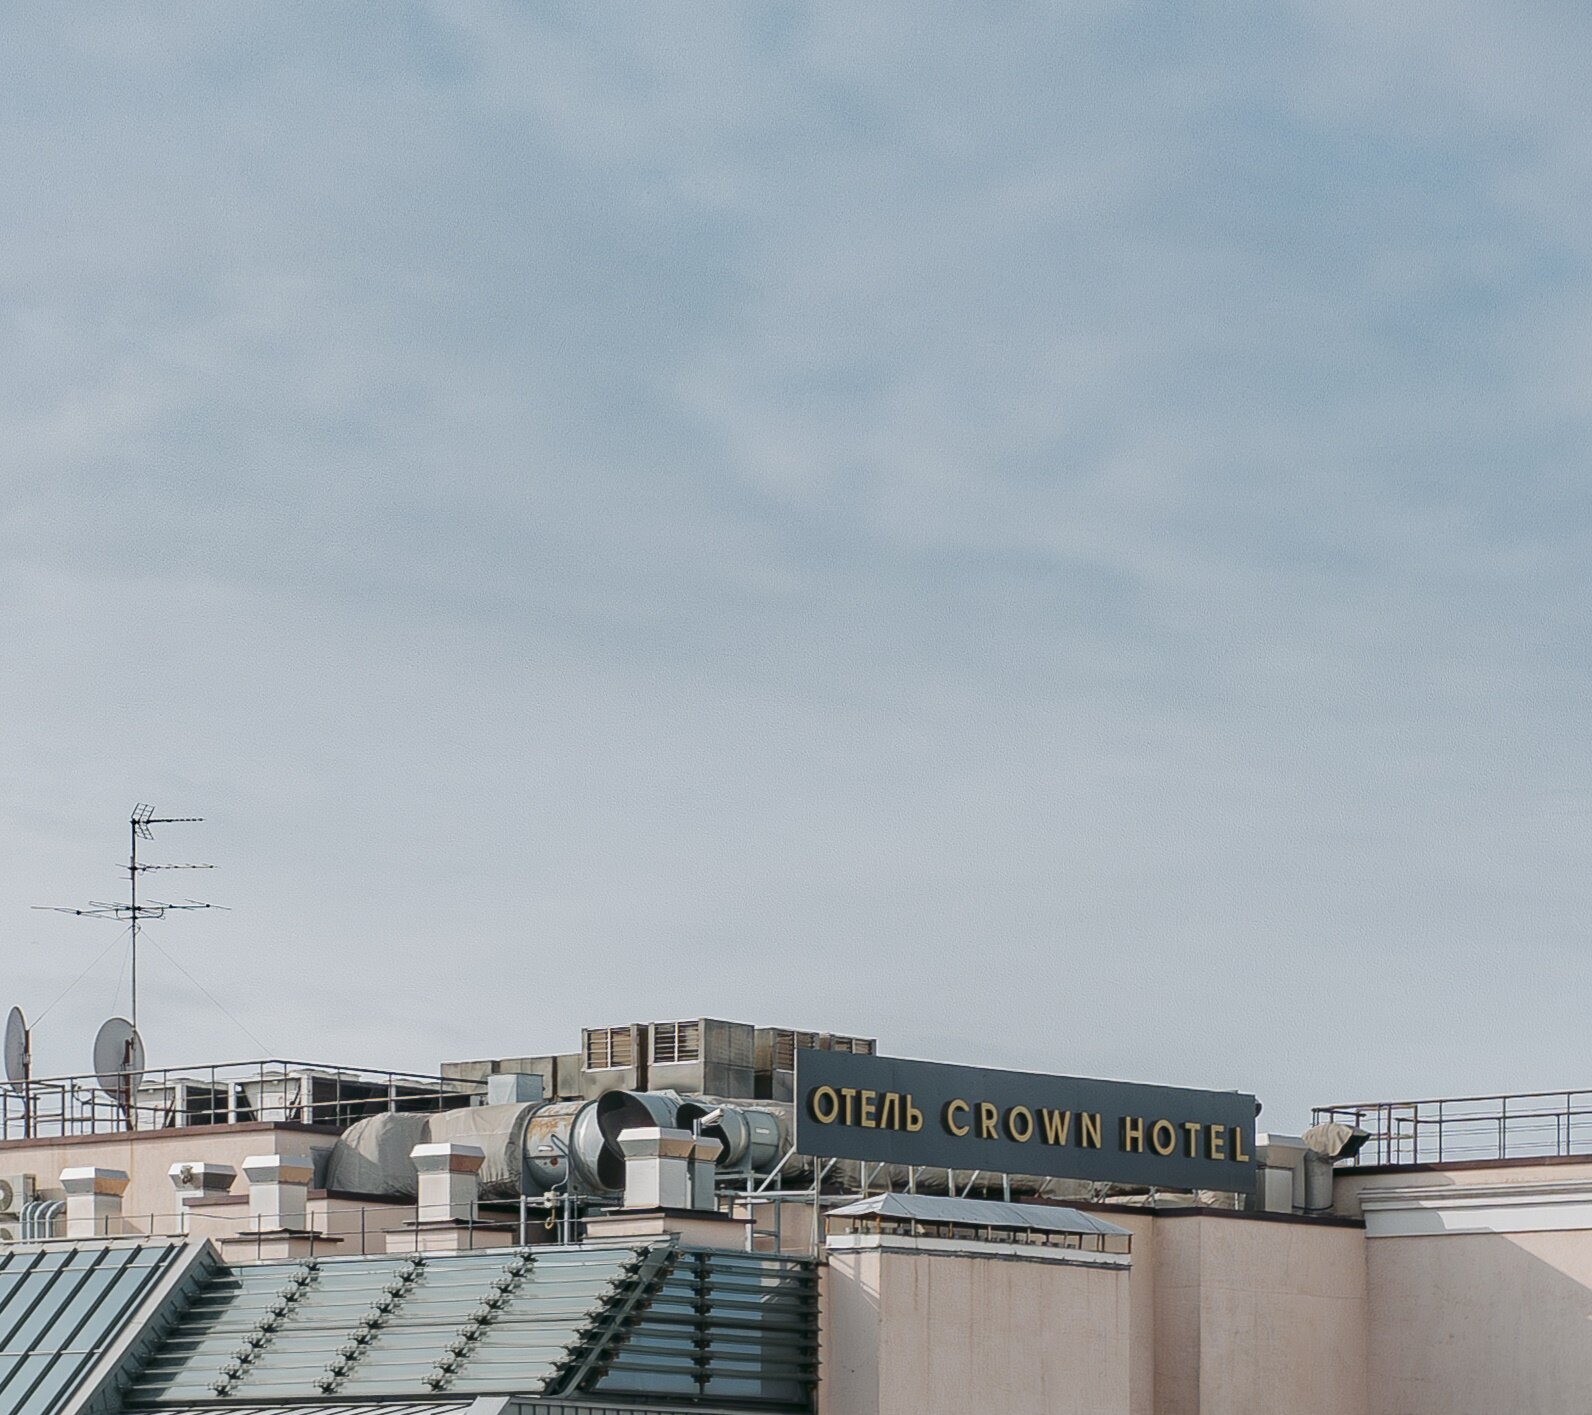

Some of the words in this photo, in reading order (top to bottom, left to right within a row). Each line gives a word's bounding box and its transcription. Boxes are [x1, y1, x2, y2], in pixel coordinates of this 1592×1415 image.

[812, 1084, 924, 1134] ОТЕЛЬ
[946, 1097, 1103, 1151] CROWN
[1120, 1115, 1250, 1164] HOTEL
